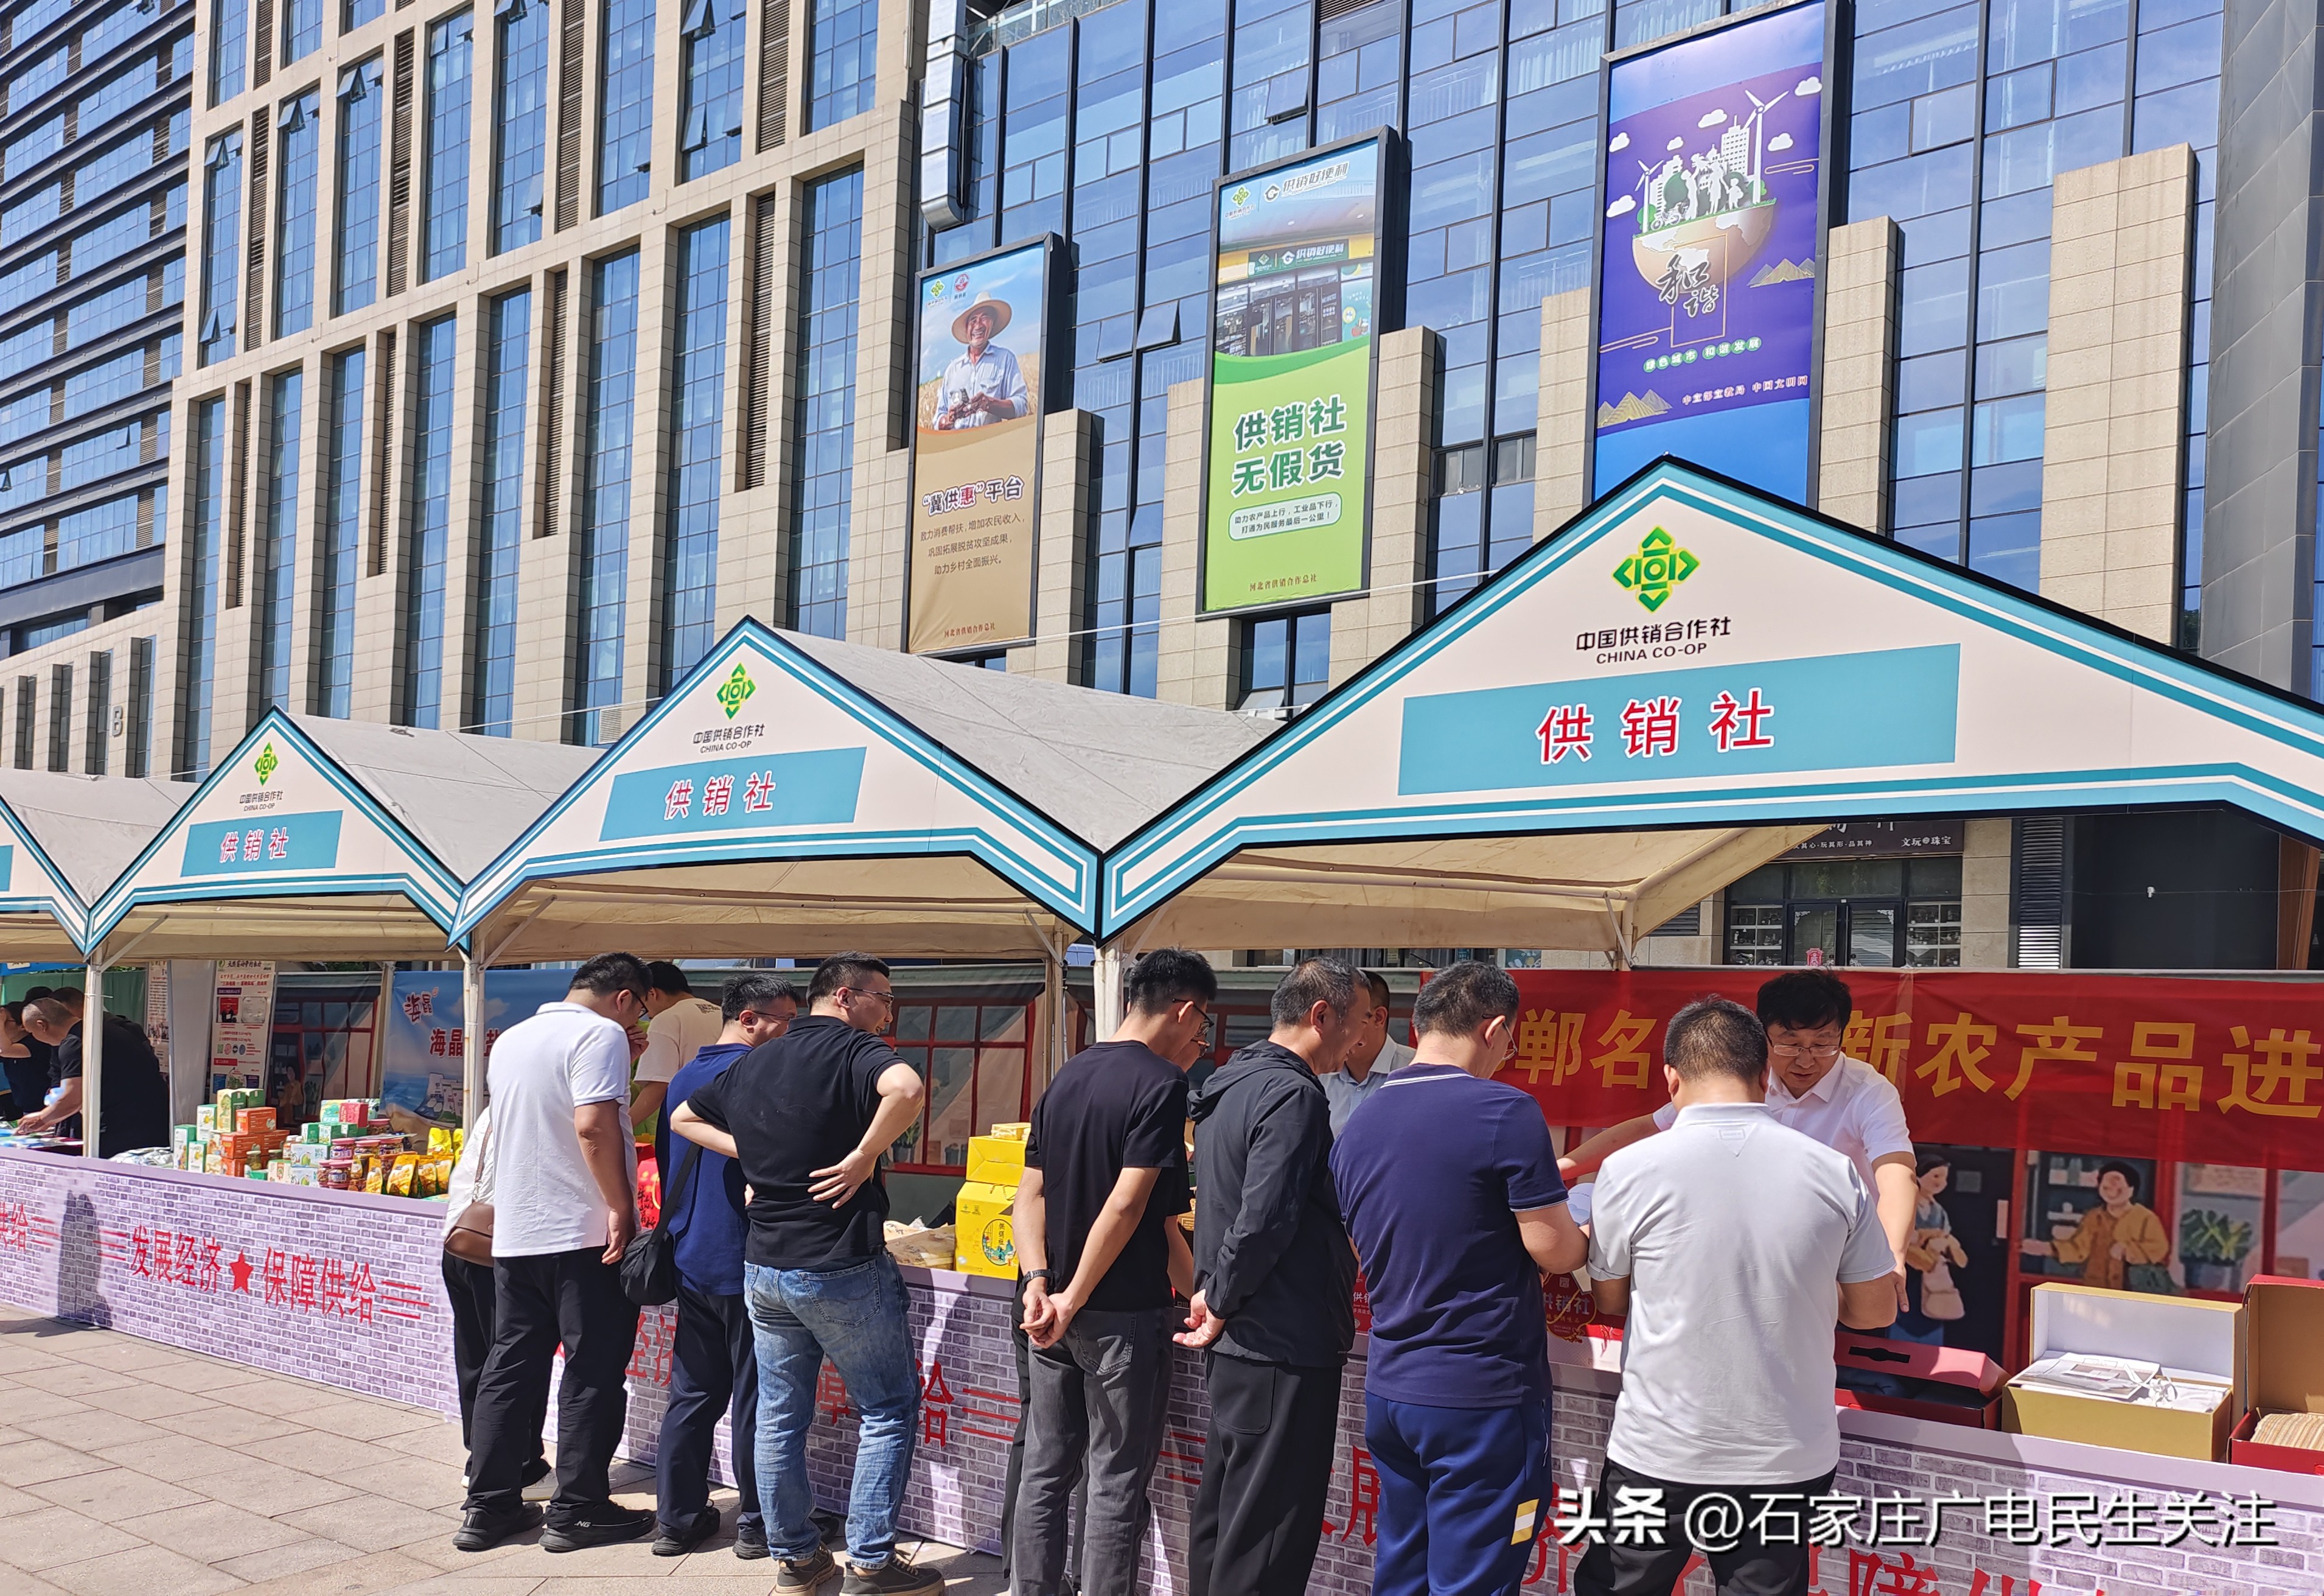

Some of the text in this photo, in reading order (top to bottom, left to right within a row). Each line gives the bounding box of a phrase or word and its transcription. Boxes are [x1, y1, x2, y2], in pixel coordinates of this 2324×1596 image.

[1705, 338, 1760, 358] 和谐发展
[1752, 375, 1808, 393] 中国文明网
[1234, 396, 1345, 452] 供销社
[1233, 442, 1345, 496] 无假货
[1249, 573, 1317, 592] 河北省供销合作总社
[1576, 617, 1731, 651] 中国供销合作社
[1596, 643, 1708, 664] CHINA CO-OP
[693, 723, 766, 745] 中国供销合作社
[1536, 688, 1775, 766] 供销社
[700, 741, 752, 754] CHINA CO-OP
[239, 790, 284, 804] 中国供销合作社
[664, 770, 776, 821] 供销社
[220, 827, 289, 863] 供销社
[130, 1225, 377, 1326] 发展经济 保障供给
